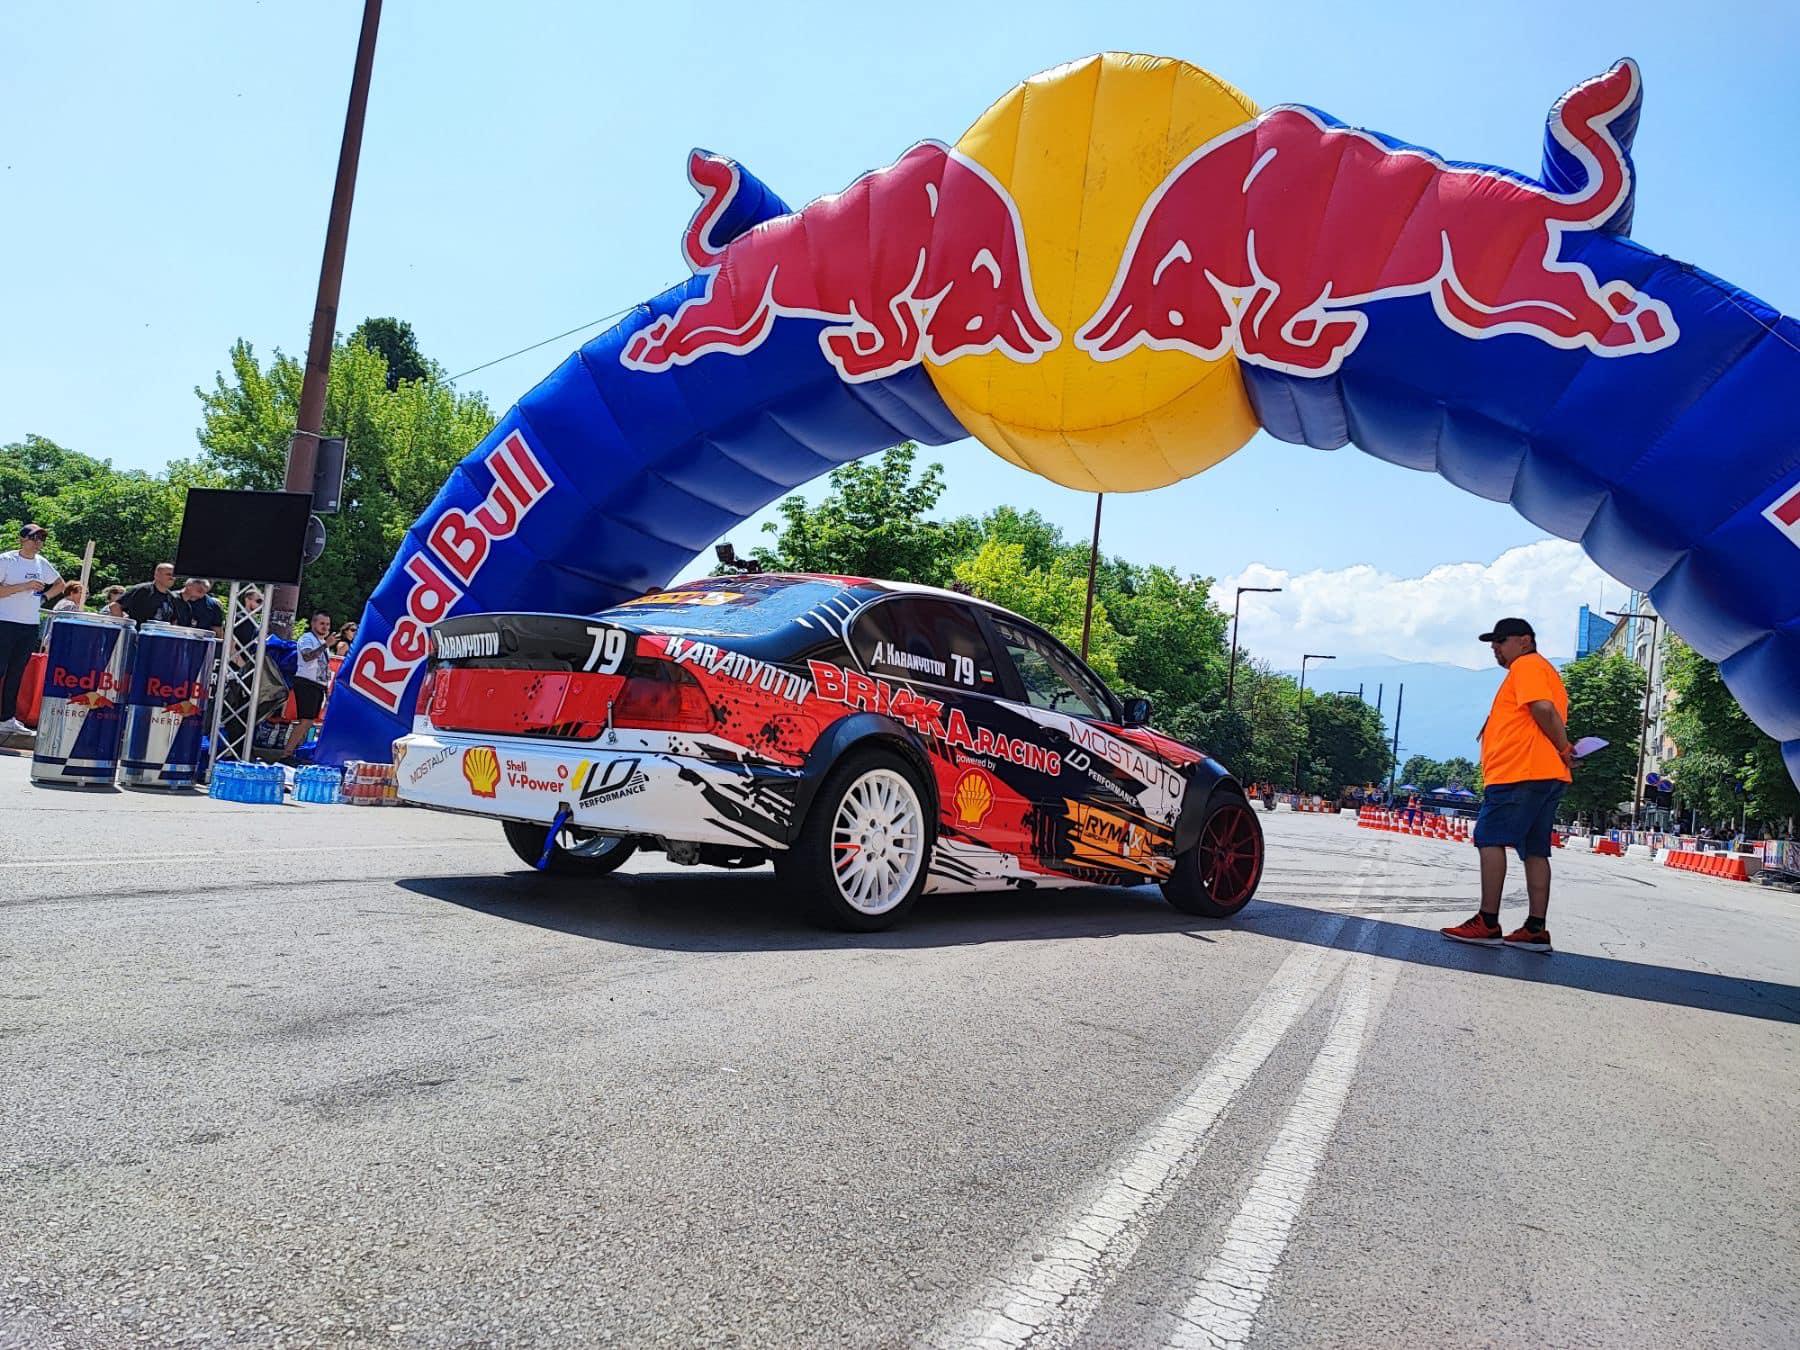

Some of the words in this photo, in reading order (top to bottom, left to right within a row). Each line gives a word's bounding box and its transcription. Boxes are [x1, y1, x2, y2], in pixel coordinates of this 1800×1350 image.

[351, 554, 462, 711] Red
[428, 431, 551, 583] Bull
[582, 626, 627, 675] 79
[53, 667, 96, 689] Red
[664, 636, 813, 706] KARANYOTOV
[950, 653, 975, 686] 79
[146, 677, 188, 699] Red
[409, 745, 458, 785] MOSTAUTO
[506, 760, 527, 772] Shell
[956, 754, 986, 767] powered
[987, 757, 997, 772] by
[1069, 720, 1181, 799] MOSTAUTO
[507, 773, 564, 793] V-Power
[579, 784, 646, 810] PERFORMANCE
[1087, 768, 1138, 807] PERFORMANCE
[1085, 815, 1145, 851] RYMAX
